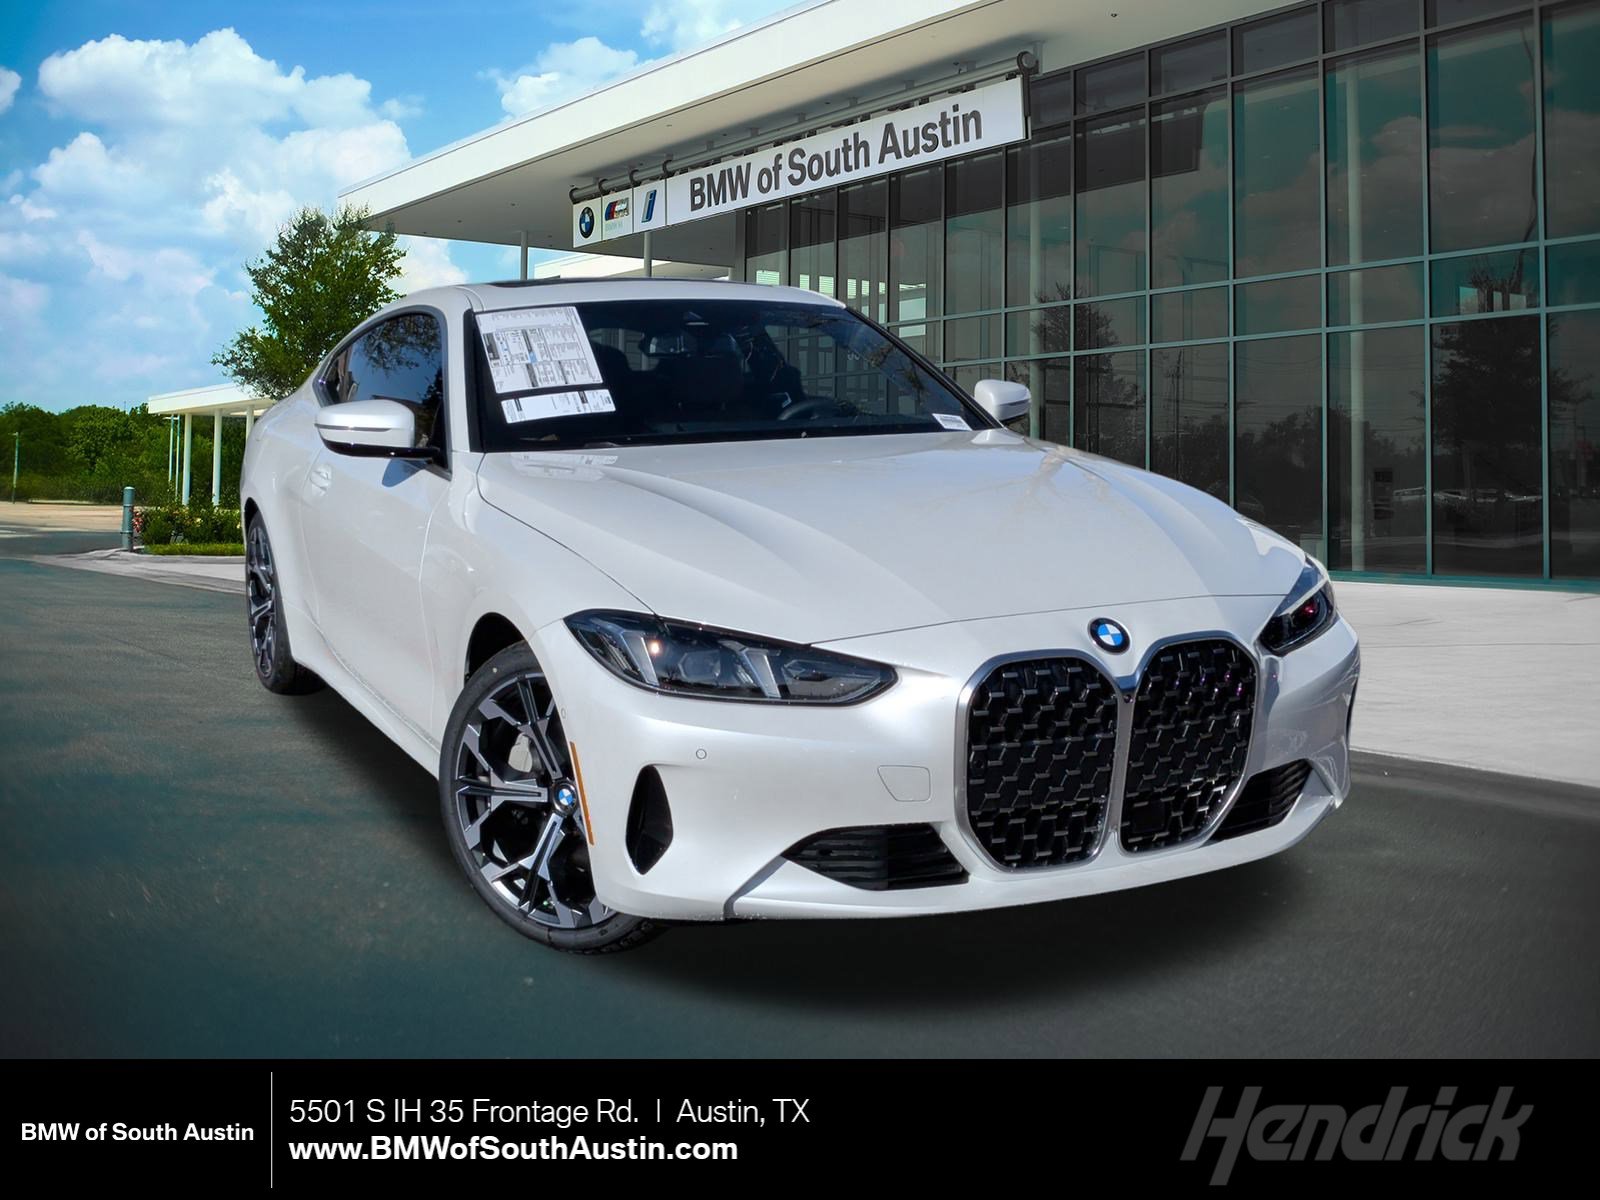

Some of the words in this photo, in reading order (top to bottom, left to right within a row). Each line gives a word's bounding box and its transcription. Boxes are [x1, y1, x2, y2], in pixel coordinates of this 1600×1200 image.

[690, 163, 751, 211] BMW
[757, 153, 783, 194] of
[788, 132, 870, 186] South
[878, 104, 983, 164] Austin
